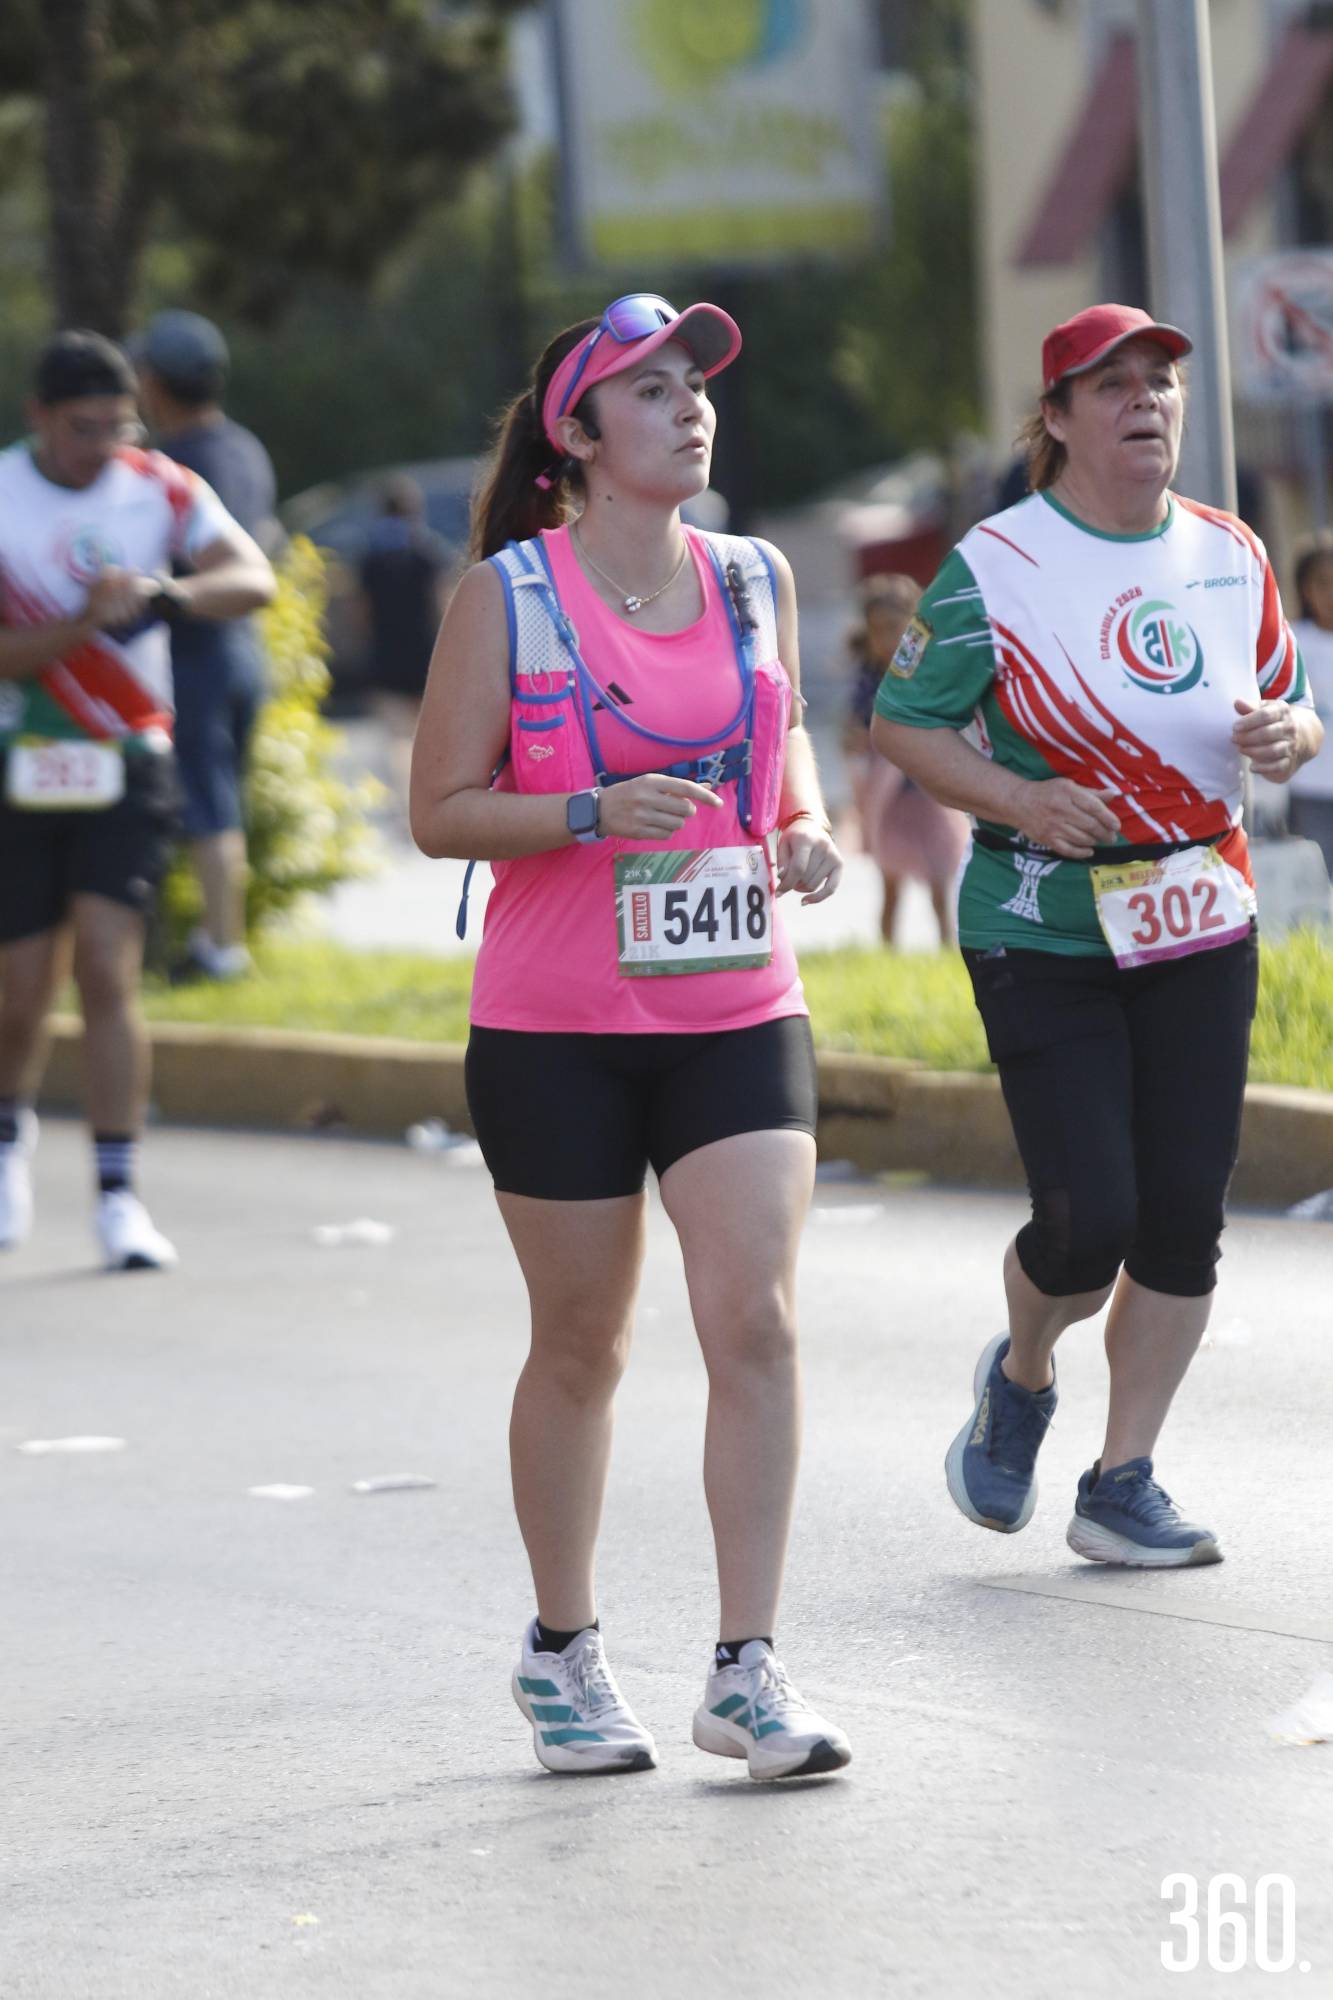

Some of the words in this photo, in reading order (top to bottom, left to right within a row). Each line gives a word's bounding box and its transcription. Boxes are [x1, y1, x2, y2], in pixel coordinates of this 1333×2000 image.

[1204, 576, 1247, 588] BROOKS
[636, 895, 649, 939] SALTILLO
[664, 884, 767, 945] 5418
[1127, 878, 1227, 945] 302
